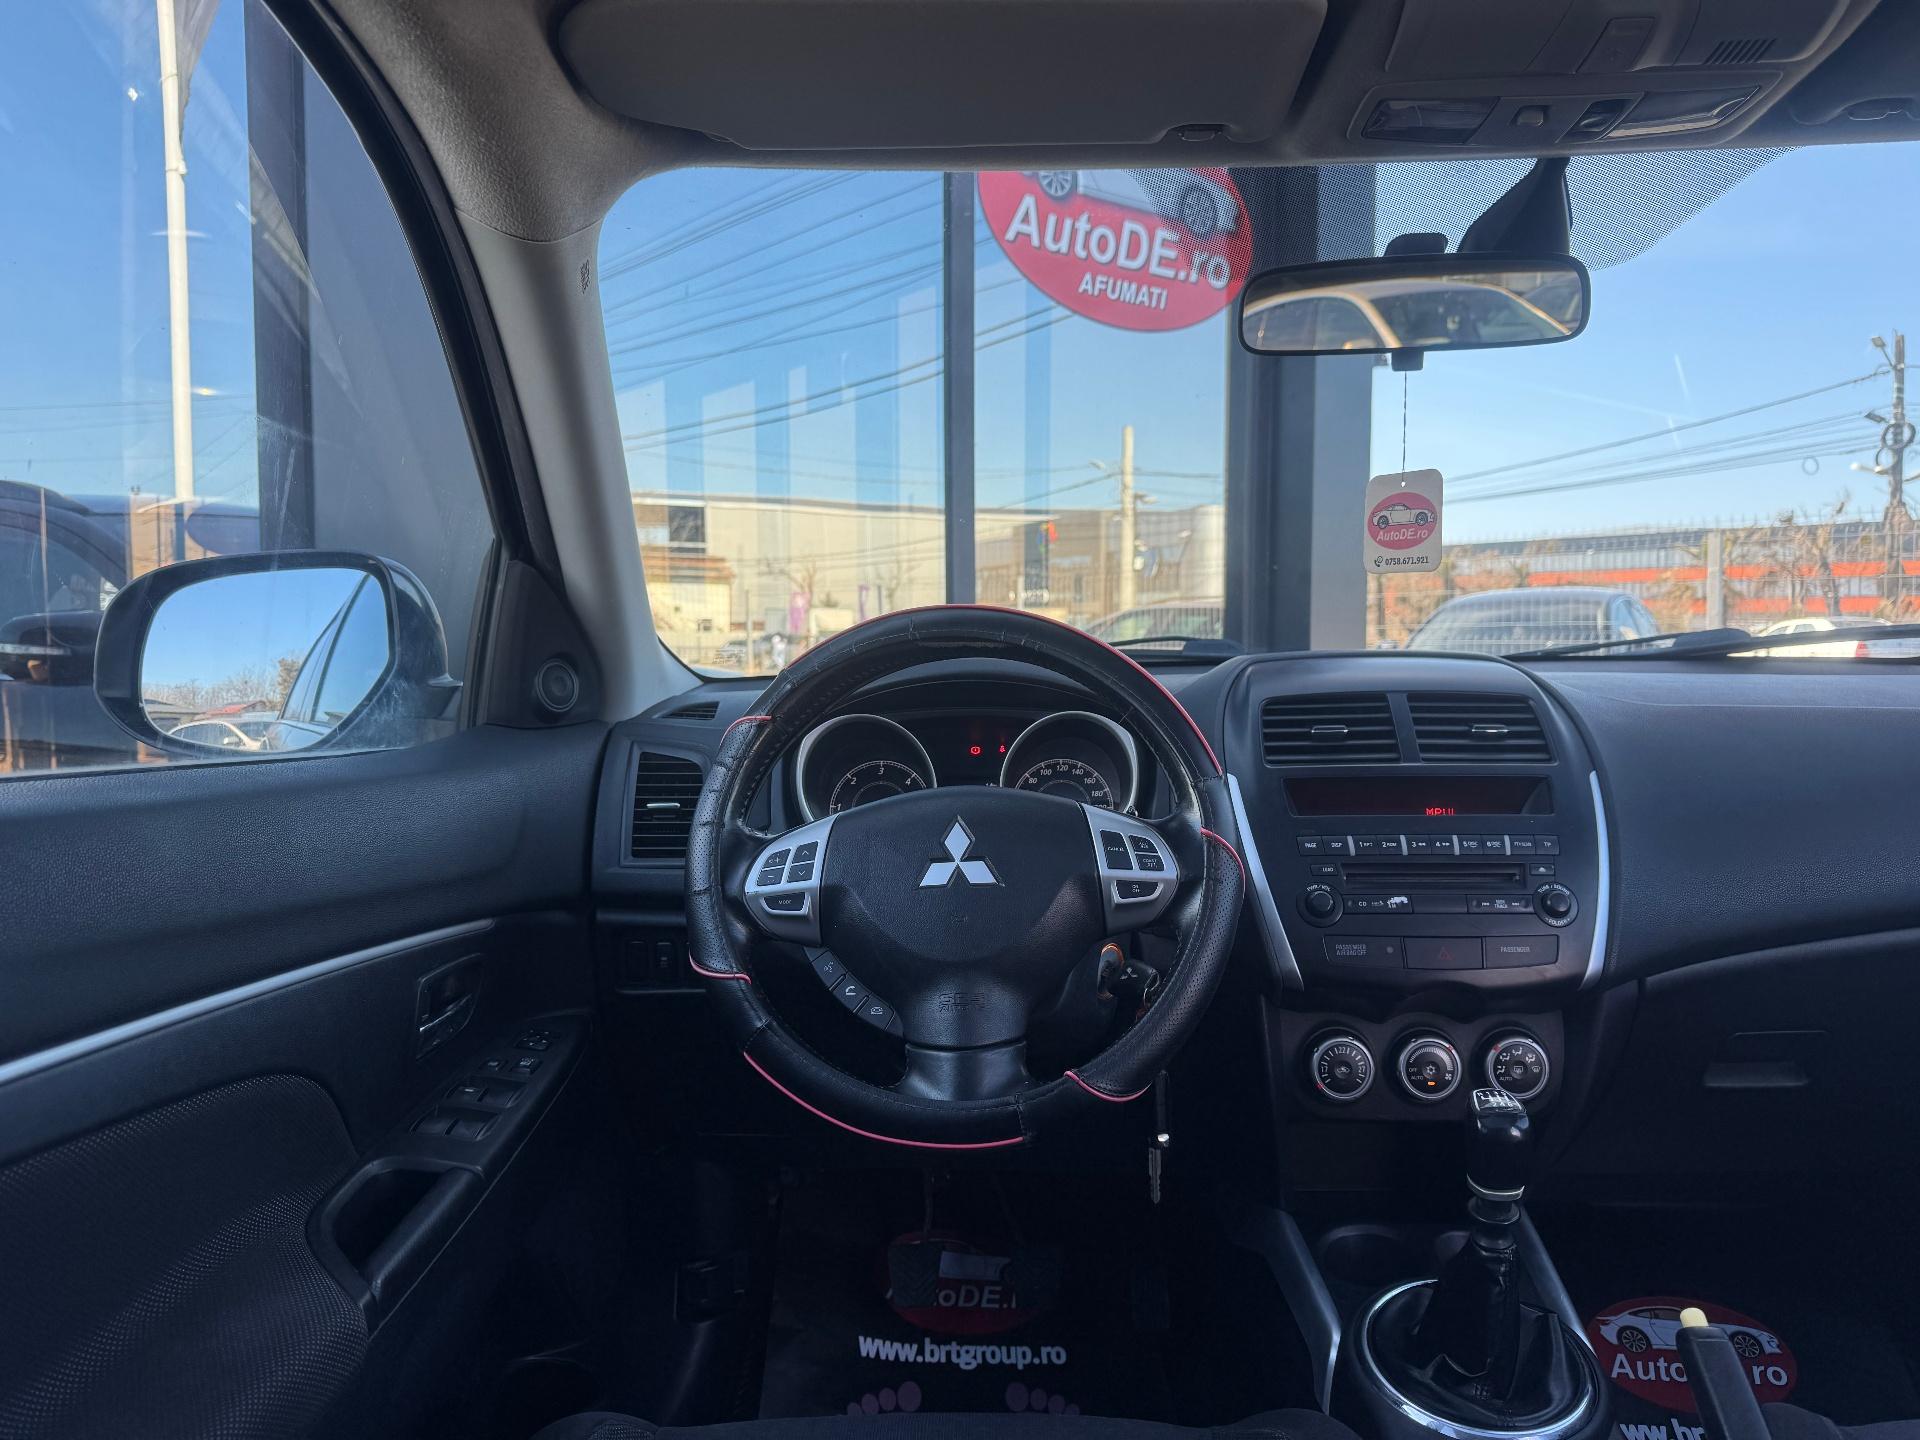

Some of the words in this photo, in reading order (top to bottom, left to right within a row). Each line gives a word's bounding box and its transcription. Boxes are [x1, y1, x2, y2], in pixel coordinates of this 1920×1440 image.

[1004, 193, 1231, 290] AutoDE.ro
[1078, 271, 1168, 310] AFUMATI
[1385, 555, 1430, 566] 0758.671.921
[878, 767, 884, 775] 3
[1040, 768, 1052, 776] 100
[850, 777, 857, 785] 2
[905, 777, 911, 786] 4
[1338, 1047, 1346, 1055] 22
[858, 1335, 1067, 1370] www.brtgroup.ro
